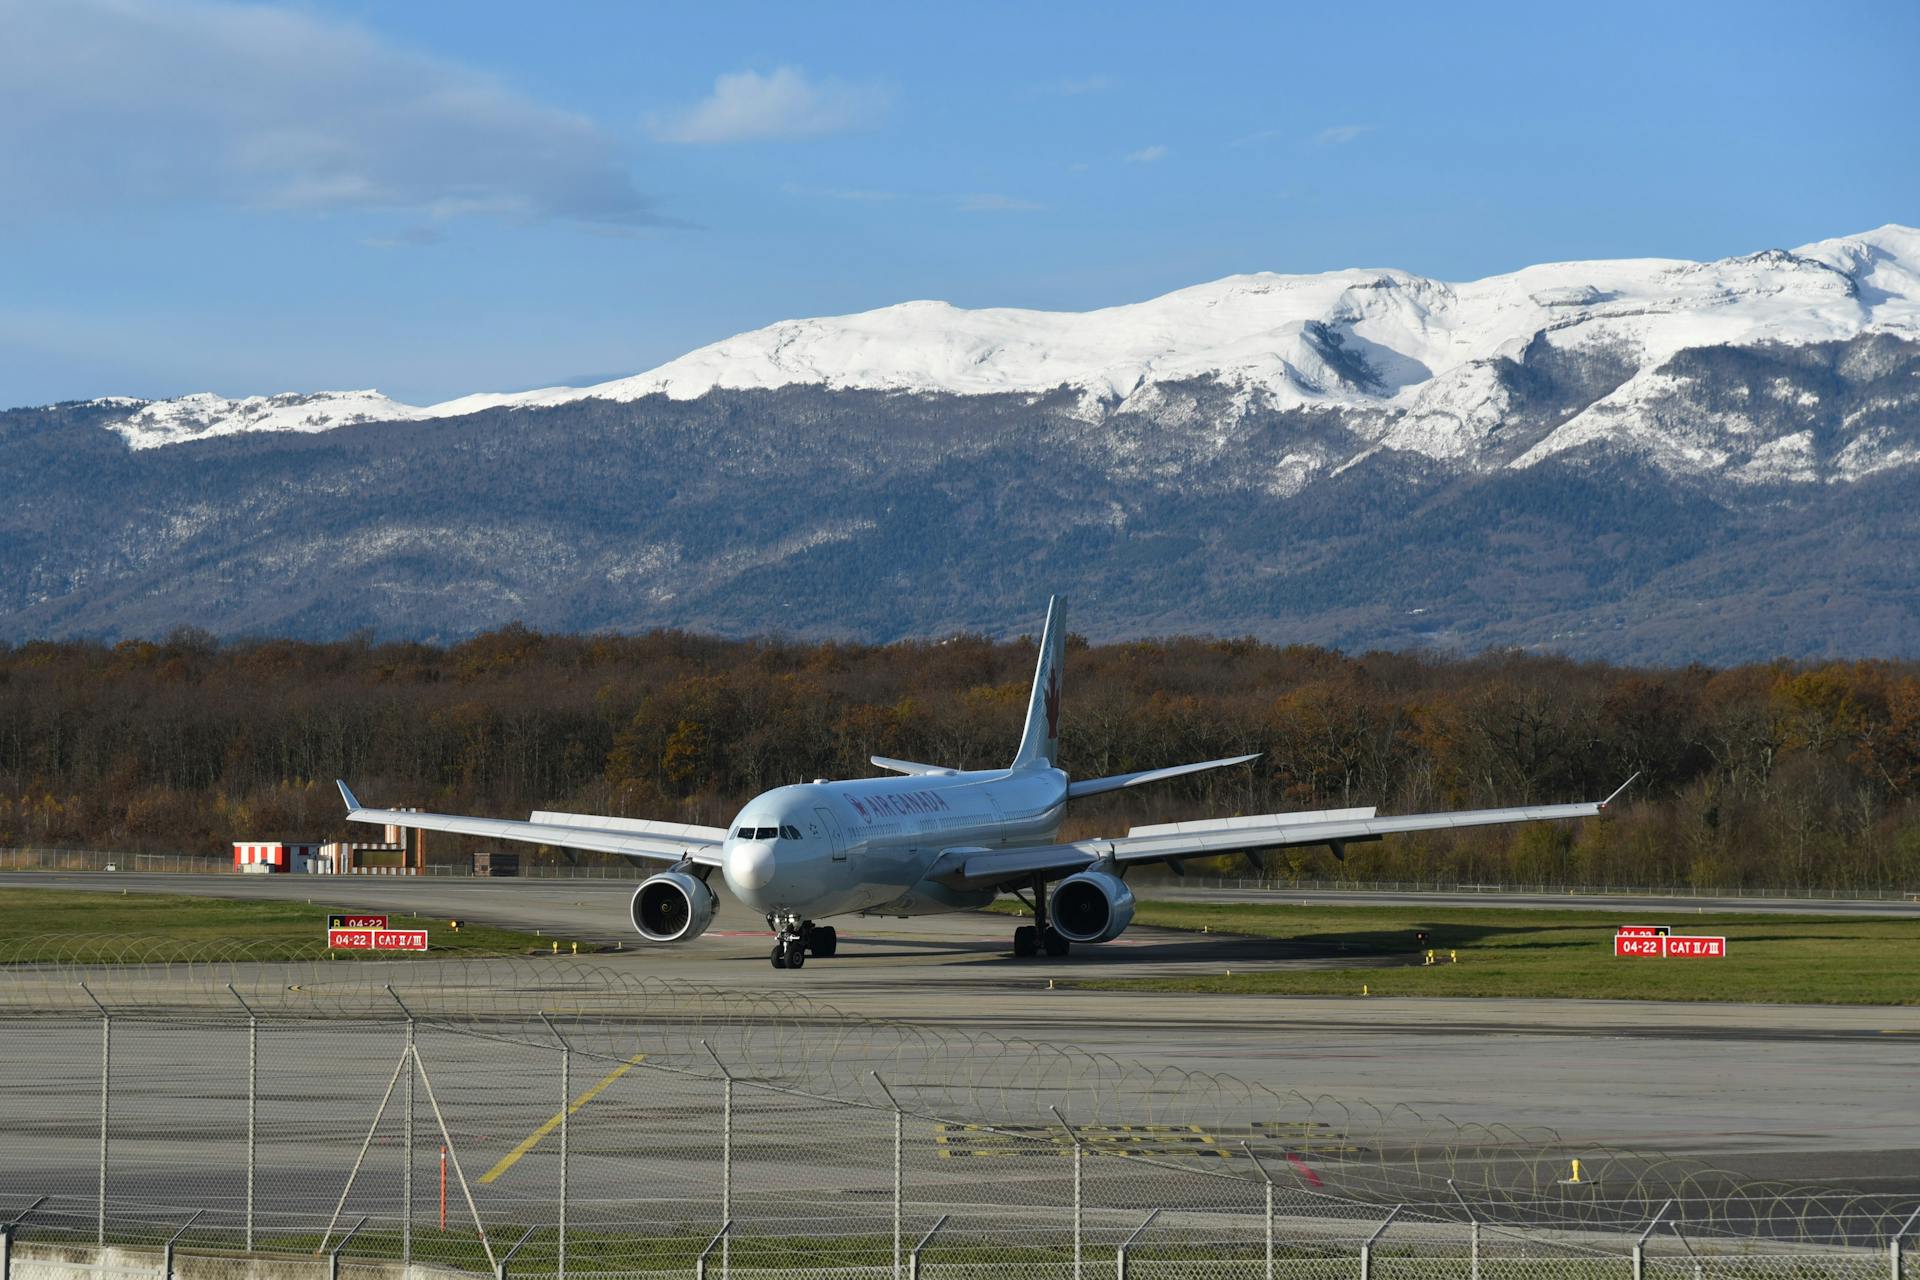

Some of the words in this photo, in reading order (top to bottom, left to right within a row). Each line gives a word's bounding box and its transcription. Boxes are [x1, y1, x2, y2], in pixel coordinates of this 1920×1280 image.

[864, 795, 897, 817] AIR
[888, 790, 950, 816] CANADA
[349, 919, 383, 928] 04-22
[335, 934, 367, 946] 04-22
[378, 935, 397, 946] CAT
[1623, 941, 1657, 953] 04-22
[1670, 942, 1691, 954] CAT
